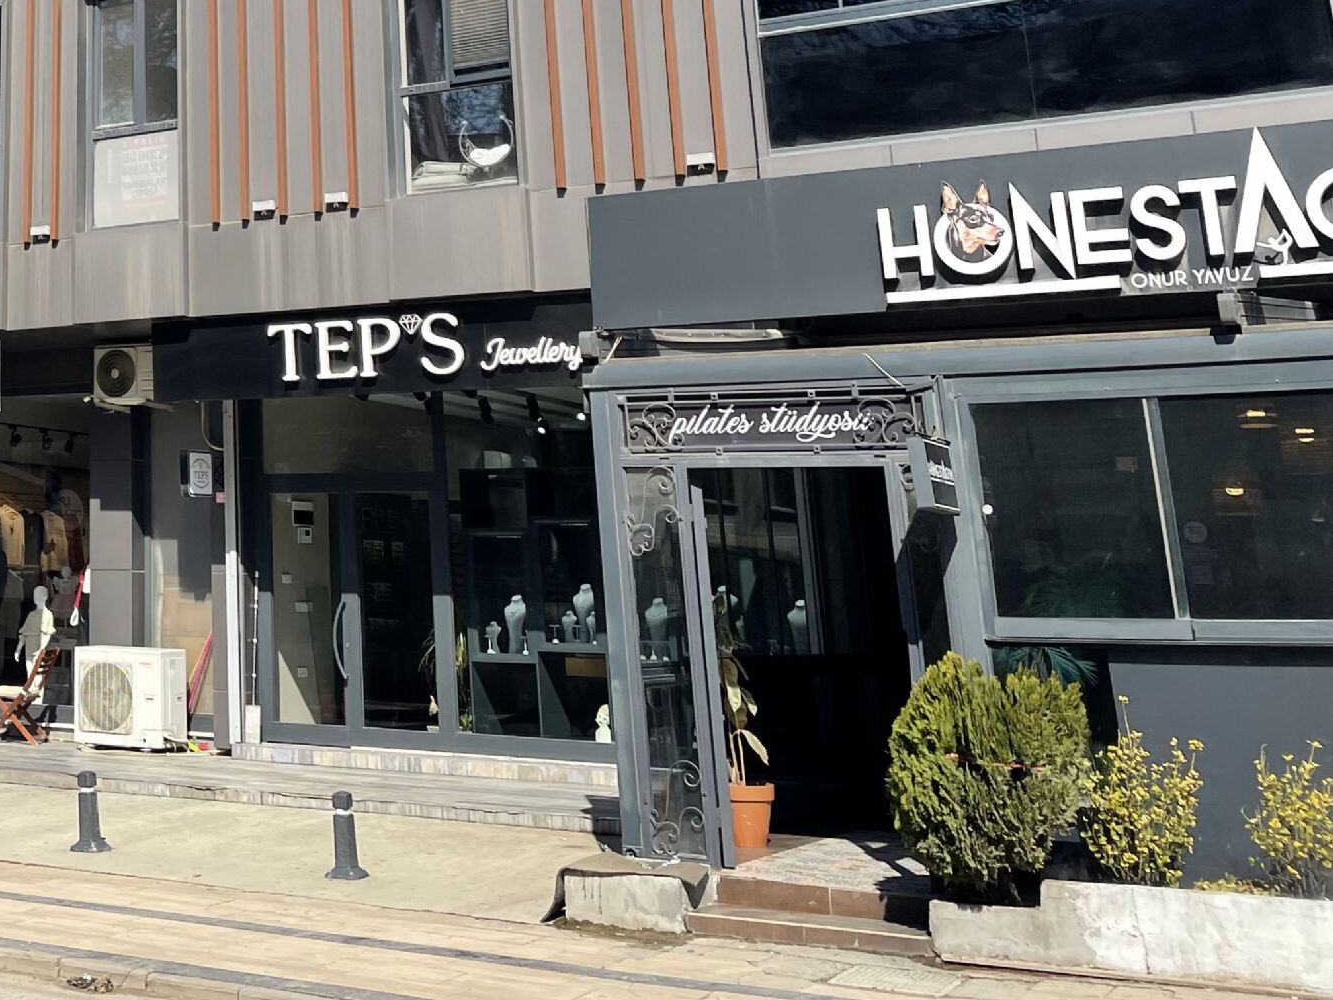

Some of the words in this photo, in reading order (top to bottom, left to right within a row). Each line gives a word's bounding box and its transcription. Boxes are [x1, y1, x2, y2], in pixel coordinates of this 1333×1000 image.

[1131, 269, 1188, 288] ONUR
[1192, 266, 1254, 285] YAVUZ
[480, 336, 583, 370] Jewellery
